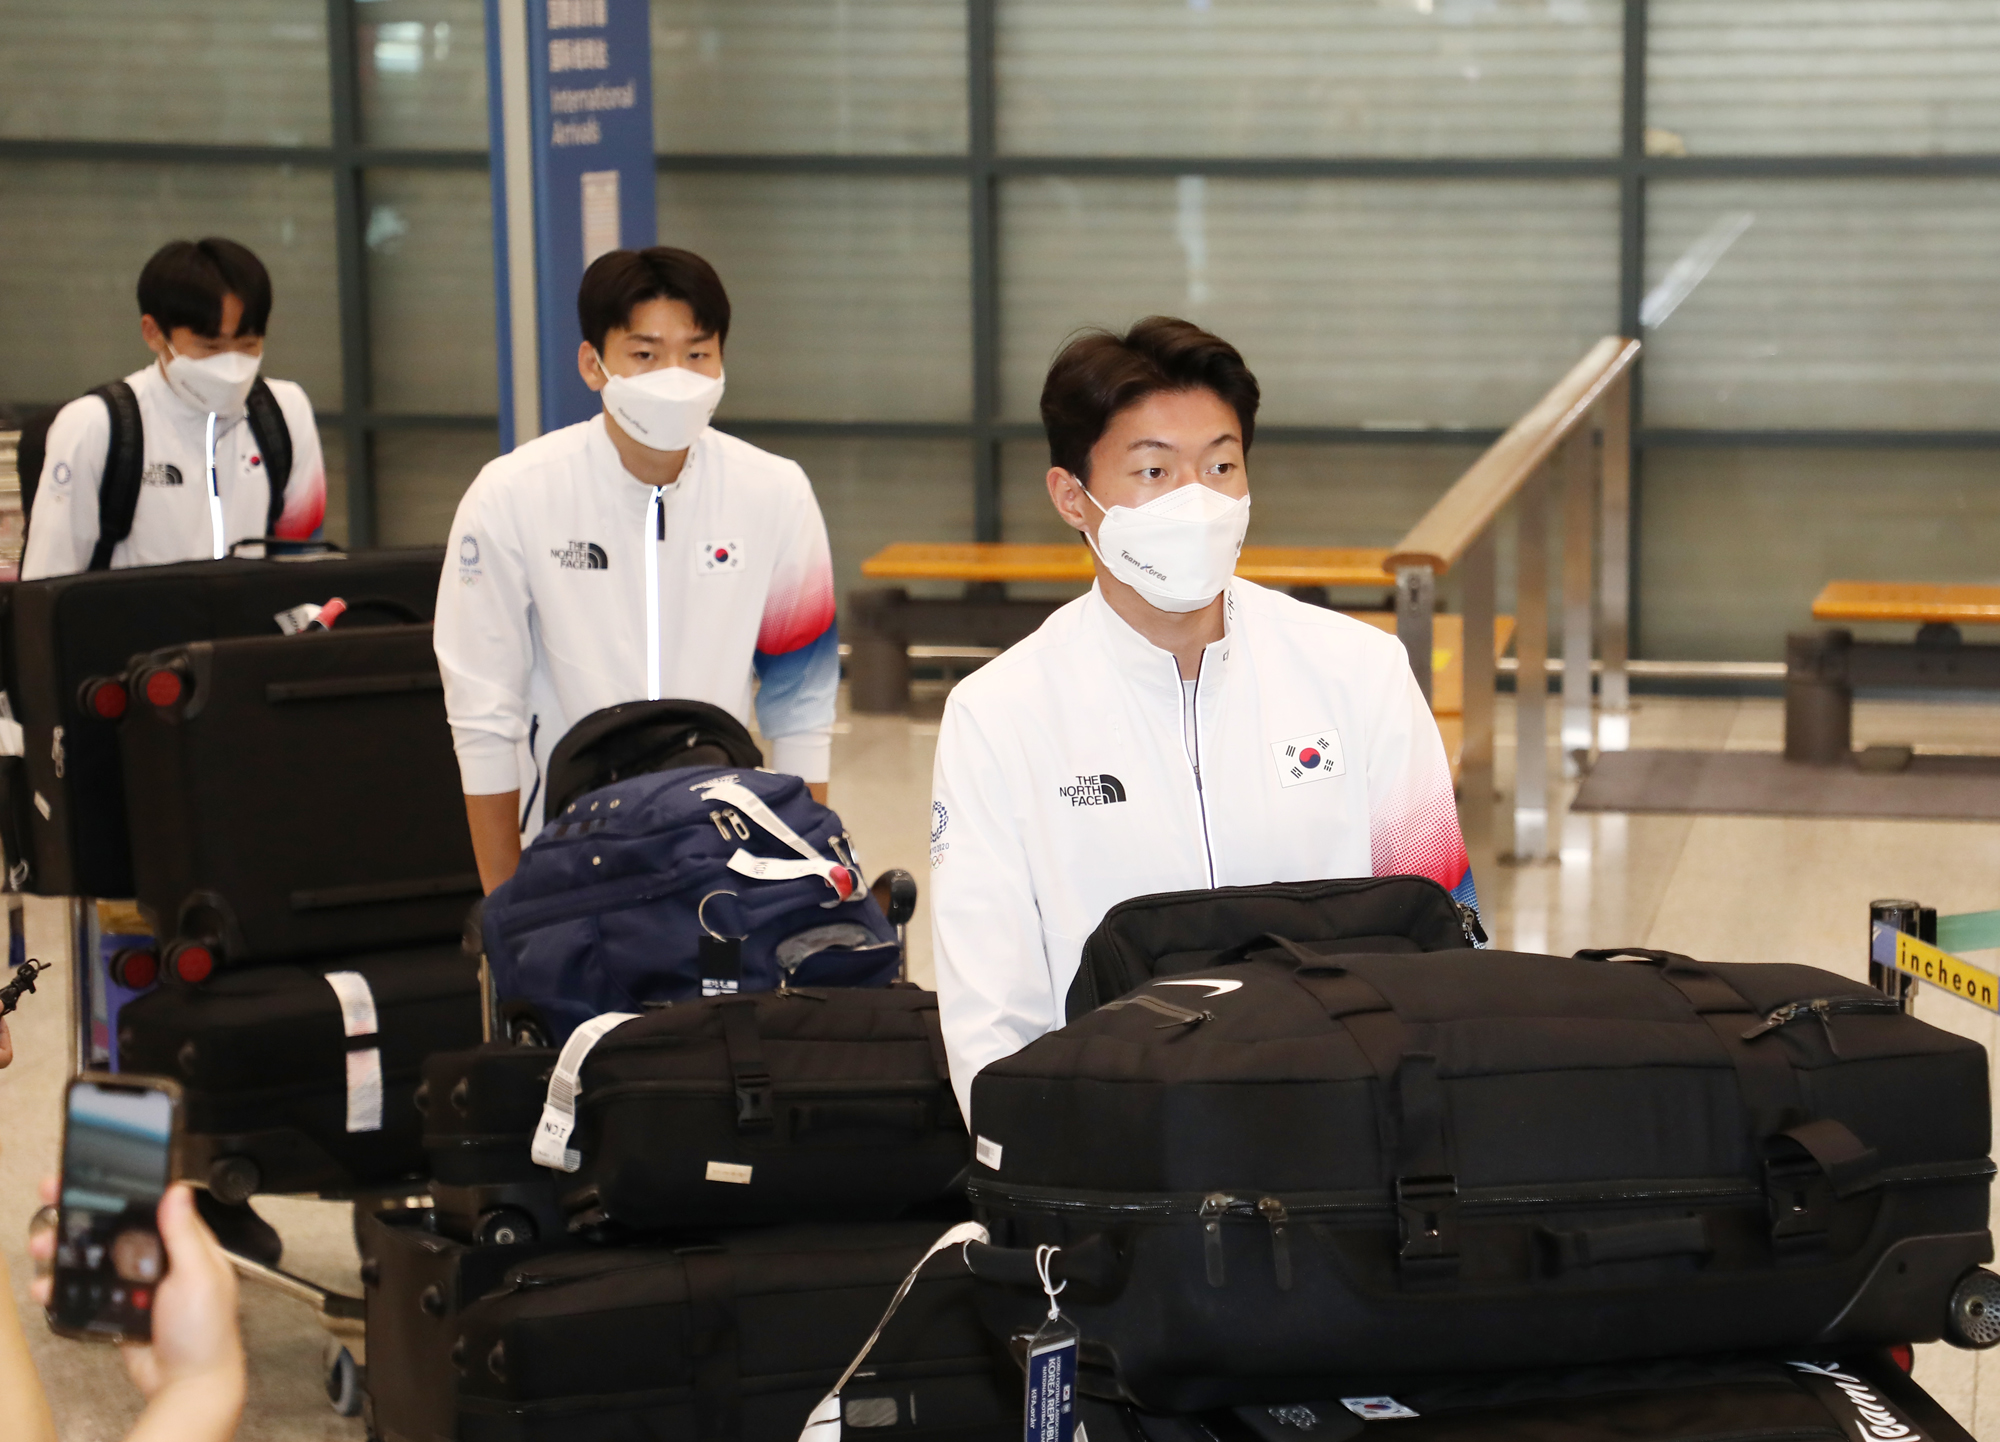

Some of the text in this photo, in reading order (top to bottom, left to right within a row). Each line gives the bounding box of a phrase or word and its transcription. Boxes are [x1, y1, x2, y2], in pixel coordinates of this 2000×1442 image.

[569, 540, 587, 551] THE
[550, 549, 587, 561] NORTH
[560, 560, 587, 569] FACE
[1121, 550, 1168, 581] Team Korea
[1076, 775, 1099, 785] THE
[1059, 785, 1102, 797] NORTH
[1071, 795, 1103, 807] FACE
[1901, 941, 1992, 1005] incheon
[1047, 1358, 1056, 1398] KOREA
